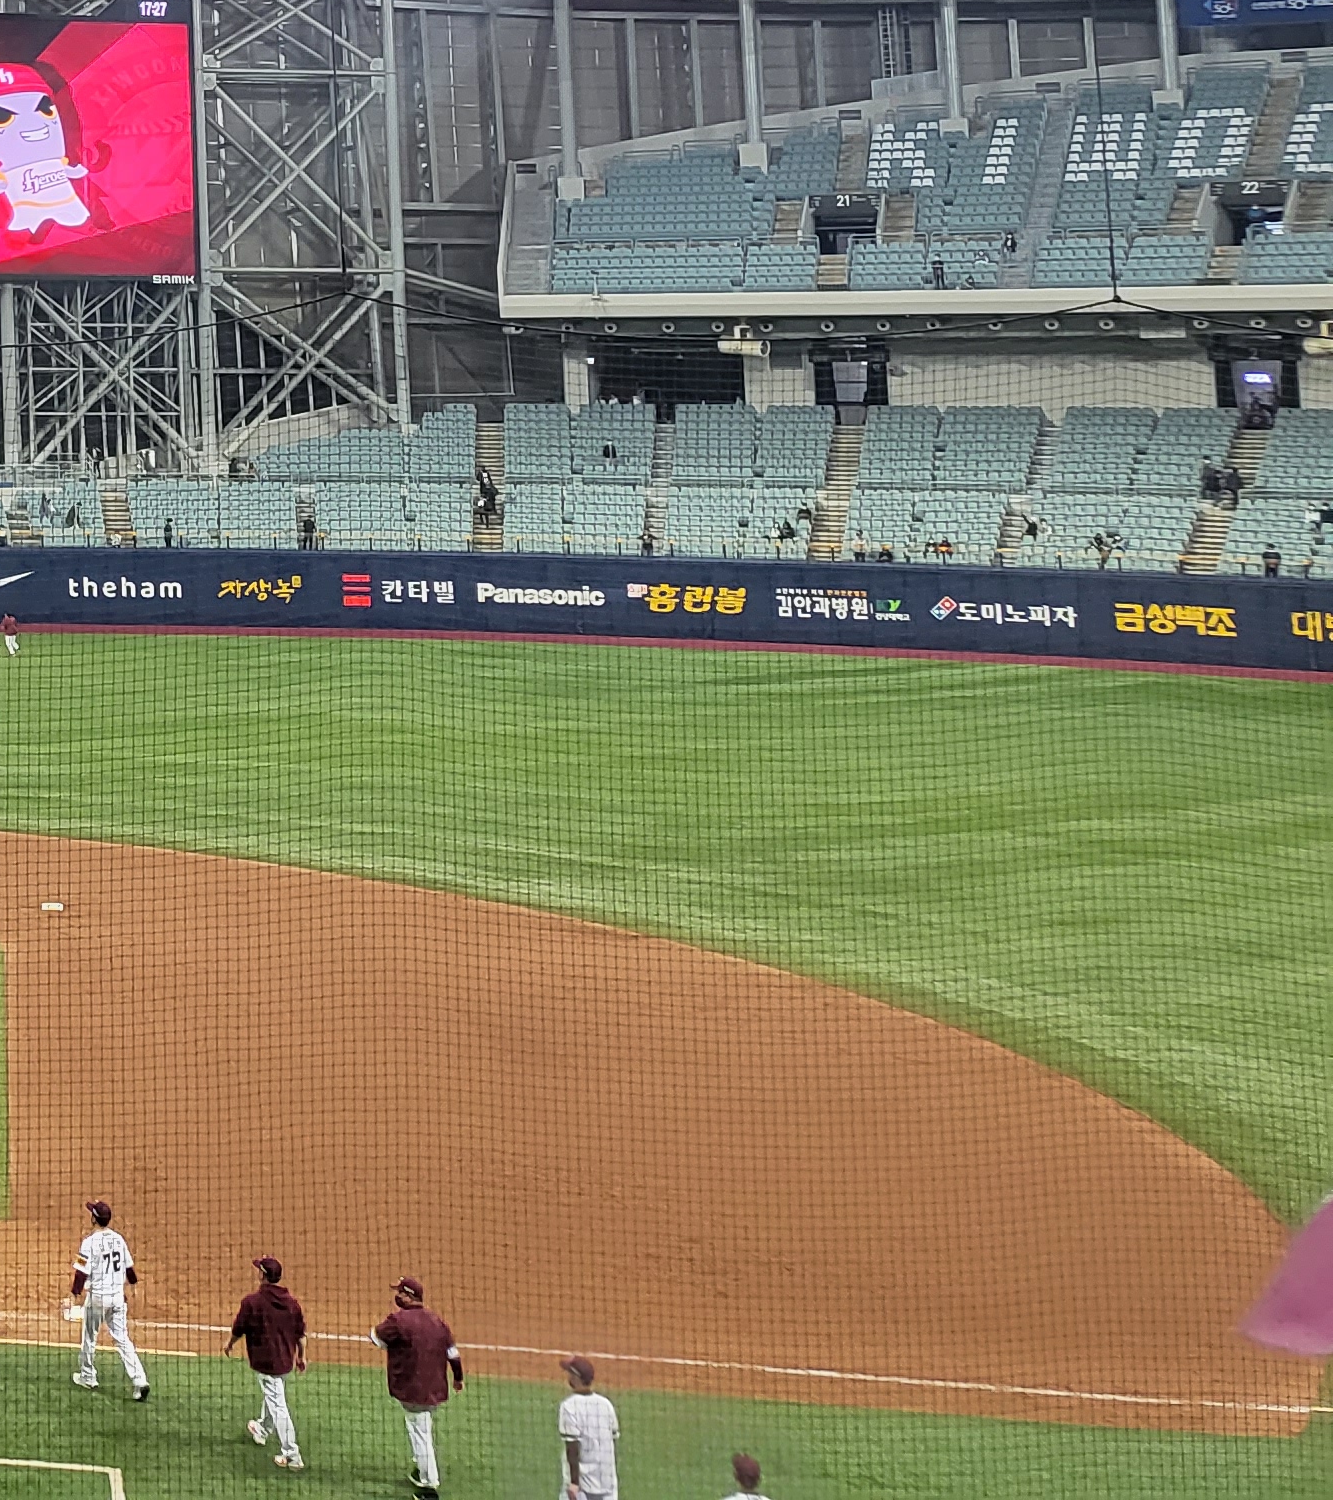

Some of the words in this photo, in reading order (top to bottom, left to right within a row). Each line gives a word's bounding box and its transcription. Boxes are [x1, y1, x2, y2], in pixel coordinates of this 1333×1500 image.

[139, 1, 168, 17] 17:27
[1241, 181, 1260, 194] 22
[836, 195, 850, 207] 21
[152, 274, 195, 285] SAMIK
[68, 576, 183, 599] theham
[381, 579, 455, 604] 칸타빌
[477, 582, 606, 607] Panasonic
[644, 583, 747, 615] 홈런볼
[776, 595, 870, 620] 김안과병원
[956, 601, 1078, 629] 도미노피자
[1114, 602, 1238, 638] 금성백조
[102, 1251, 121, 1275] 72
